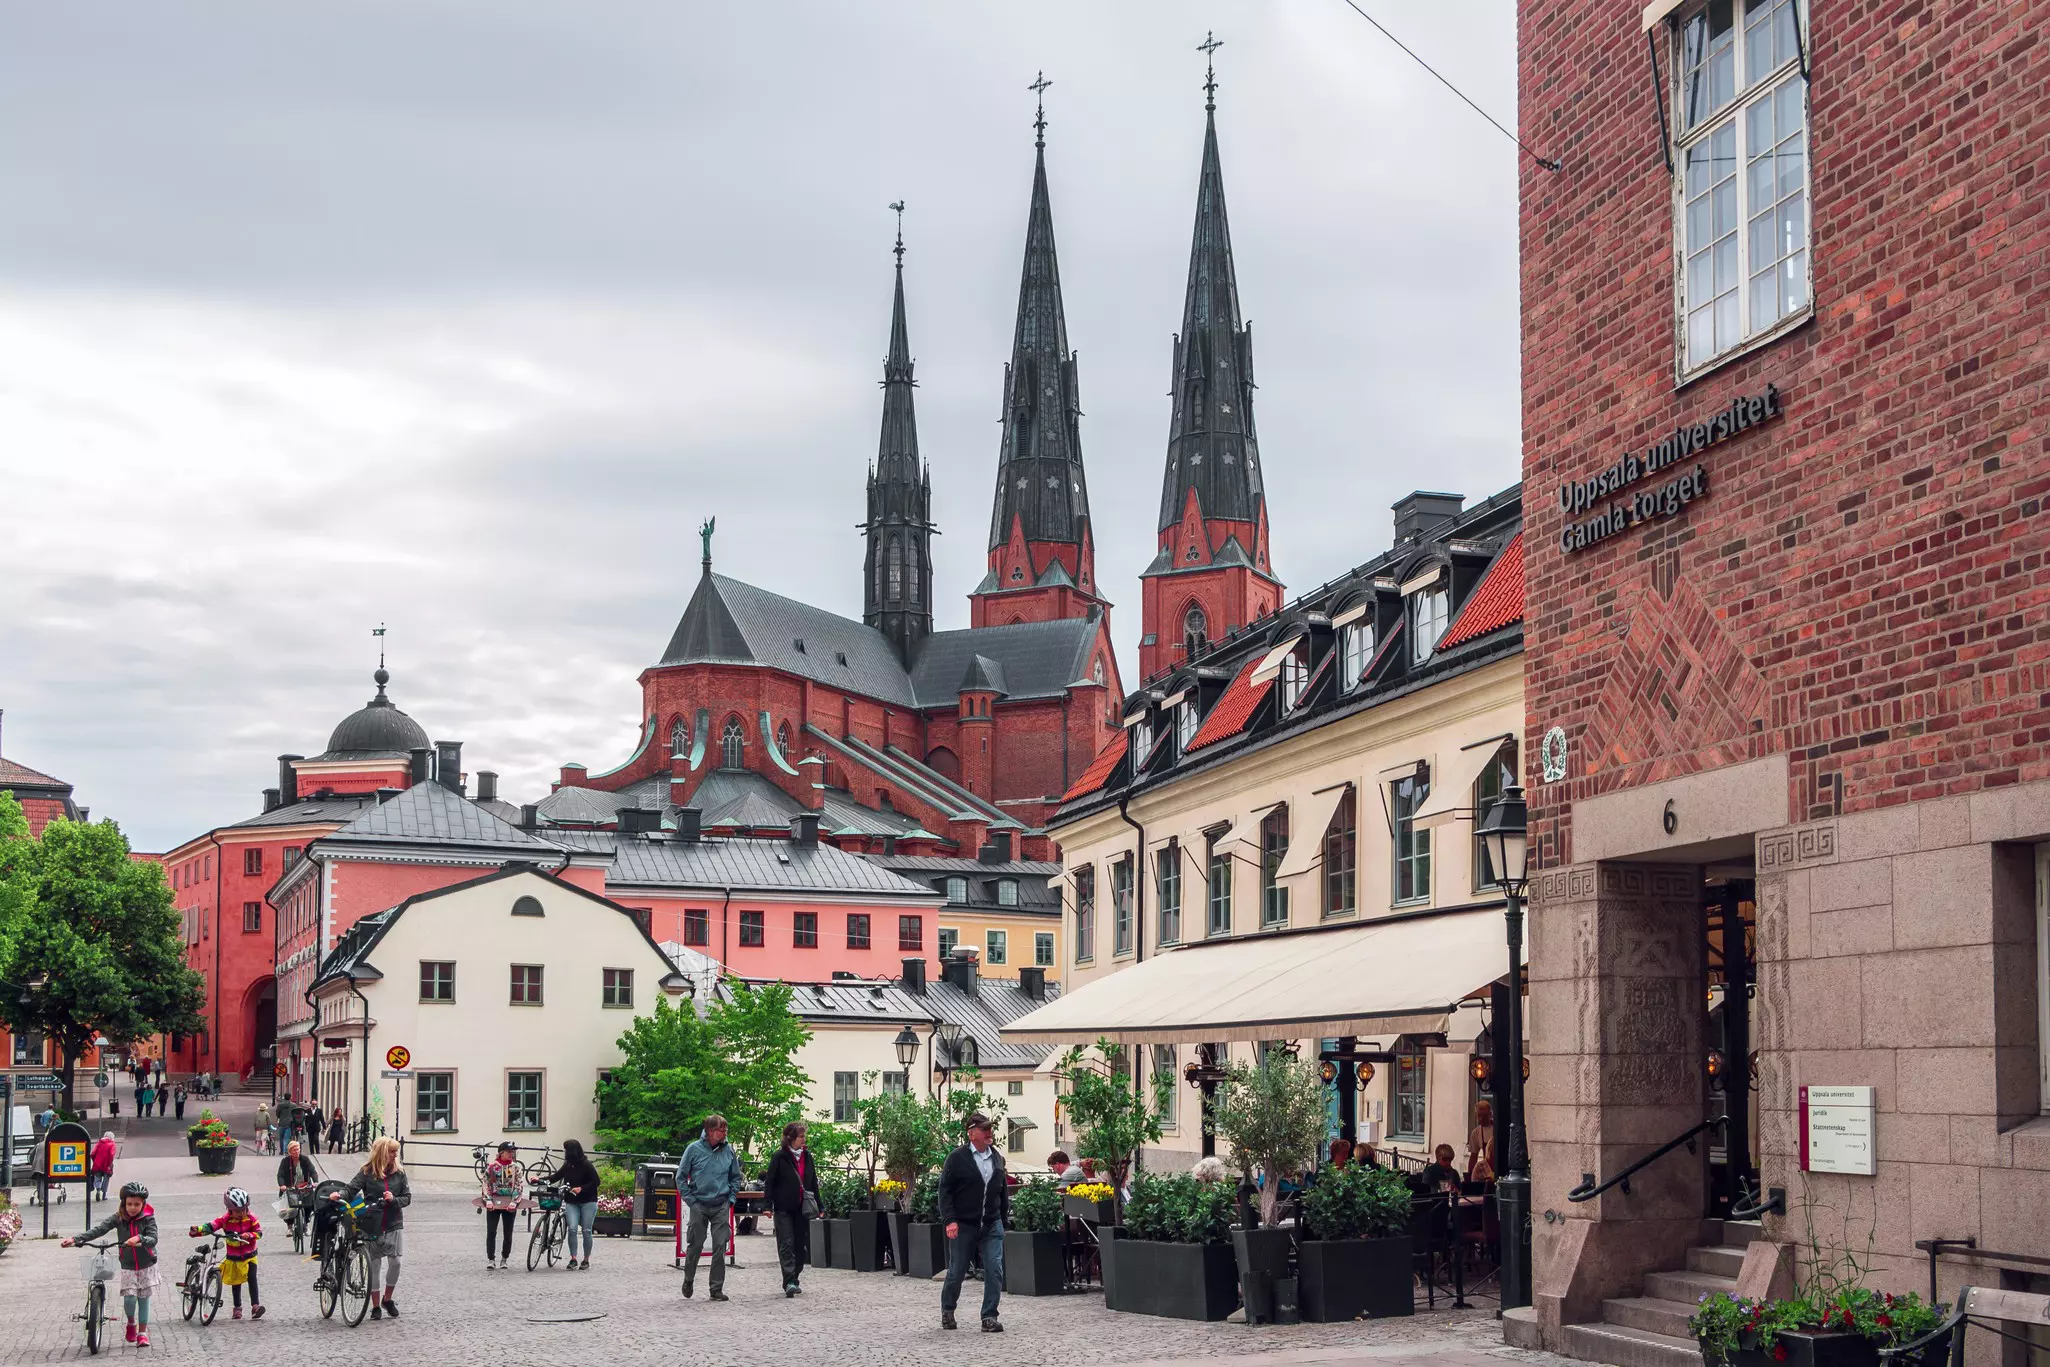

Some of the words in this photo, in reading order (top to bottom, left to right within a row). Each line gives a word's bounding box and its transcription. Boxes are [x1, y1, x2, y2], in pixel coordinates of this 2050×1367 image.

[1559, 453, 1640, 515] Uppsala
[1645, 383, 1776, 473] universitet
[1560, 502, 1627, 553] Gamla
[1632, 464, 1704, 521] torget
[1663, 797, 1677, 836] 6
[63, 1147, 74, 1160] P
